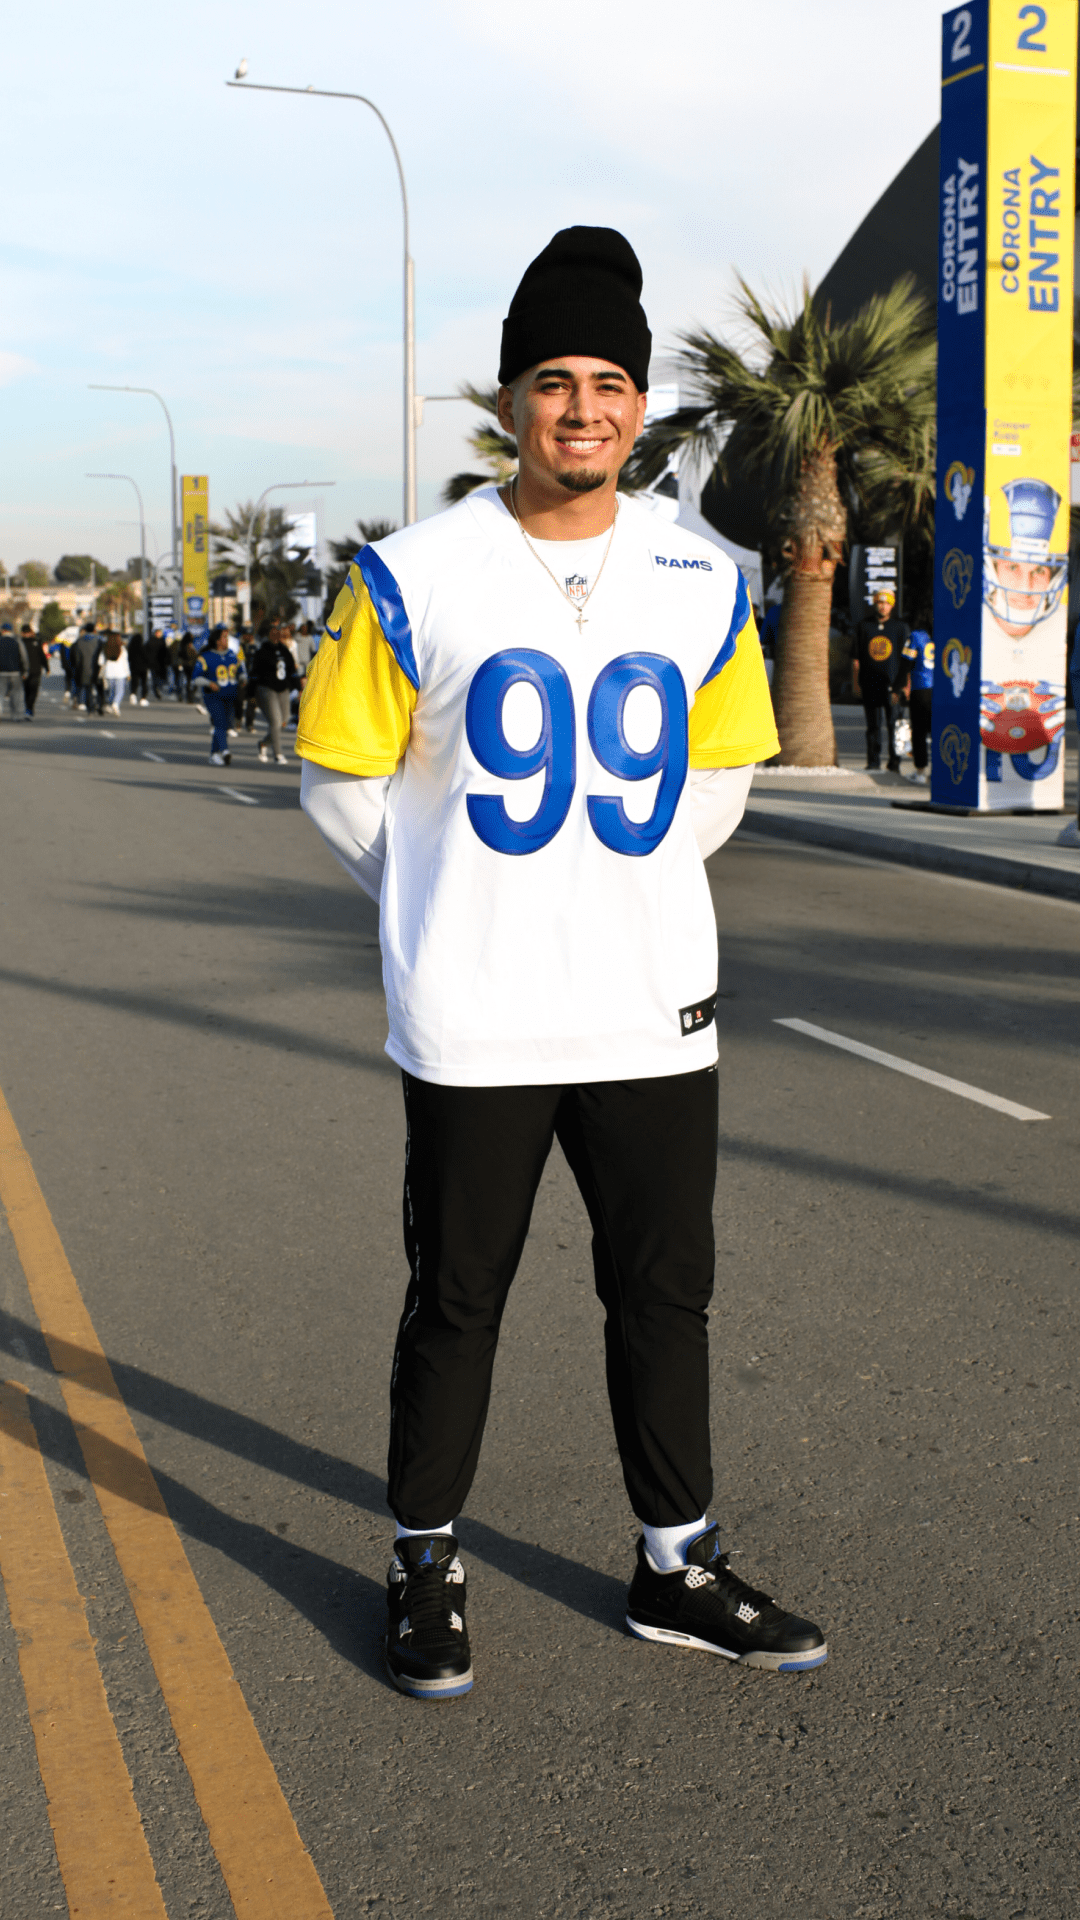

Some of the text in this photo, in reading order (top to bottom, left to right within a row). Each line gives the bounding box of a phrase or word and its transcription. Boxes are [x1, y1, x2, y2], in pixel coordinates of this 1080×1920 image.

[951, 10, 972, 62] 2
[1017, 5, 1047, 52] 2
[942, 174, 956, 302] CORONA
[957, 157, 979, 315] ENTRY
[1001, 168, 1021, 293] CORONA
[1028, 154, 1060, 312] ENTRY
[569, 585, 587, 596] NFL
[655, 555, 713, 571] RAMS
[465, 647, 690, 857] 99
